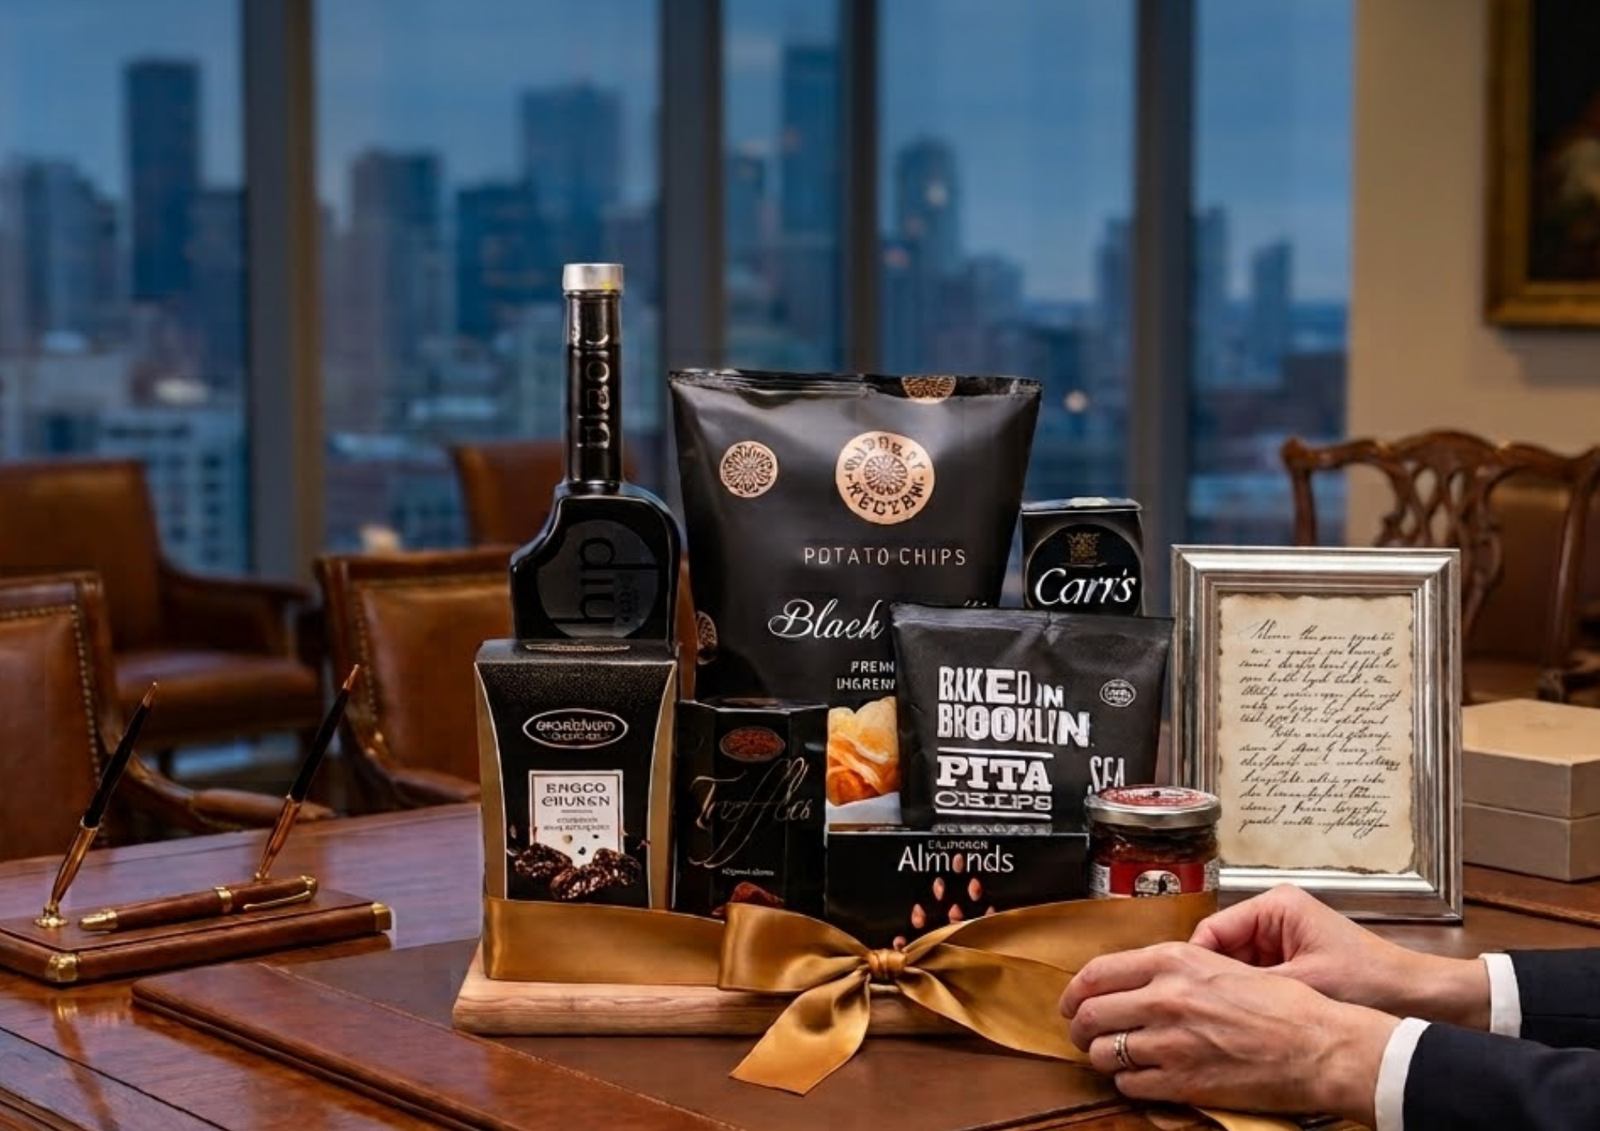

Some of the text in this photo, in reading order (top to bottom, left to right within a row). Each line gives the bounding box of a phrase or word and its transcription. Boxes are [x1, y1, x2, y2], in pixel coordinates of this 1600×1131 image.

[899, 548, 966, 566] CHIPS
[1035, 567, 1137, 605] Carr's
[767, 598, 885, 640] Black
[938, 665, 1064, 708] BAKED IN
[936, 755, 1053, 792] PITA
